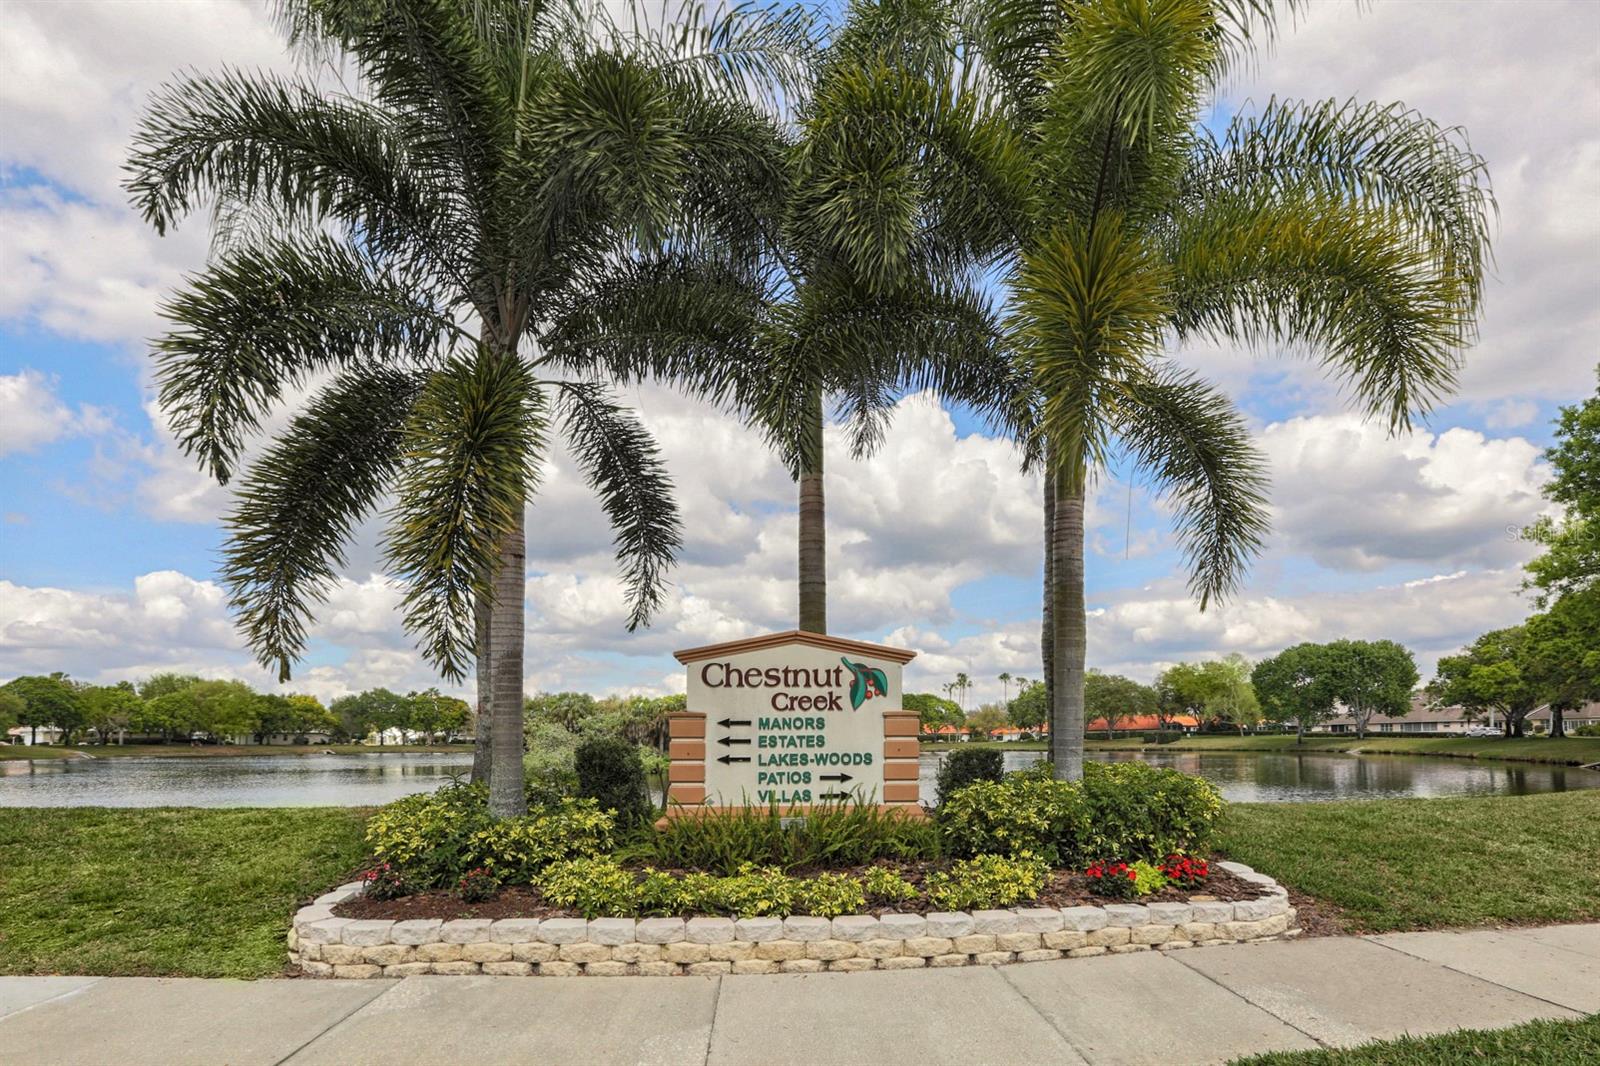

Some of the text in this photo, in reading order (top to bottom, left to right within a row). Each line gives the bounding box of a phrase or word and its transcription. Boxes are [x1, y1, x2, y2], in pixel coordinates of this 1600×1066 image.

[701, 662, 843, 688] Chestnut
[771, 691, 843, 712] Creek
[758, 717, 825, 731] MANORS
[758, 735, 825, 749] ESTATES
[758, 753, 873, 767] LAKES-WOODS
[758, 771, 812, 785] PATIOS
